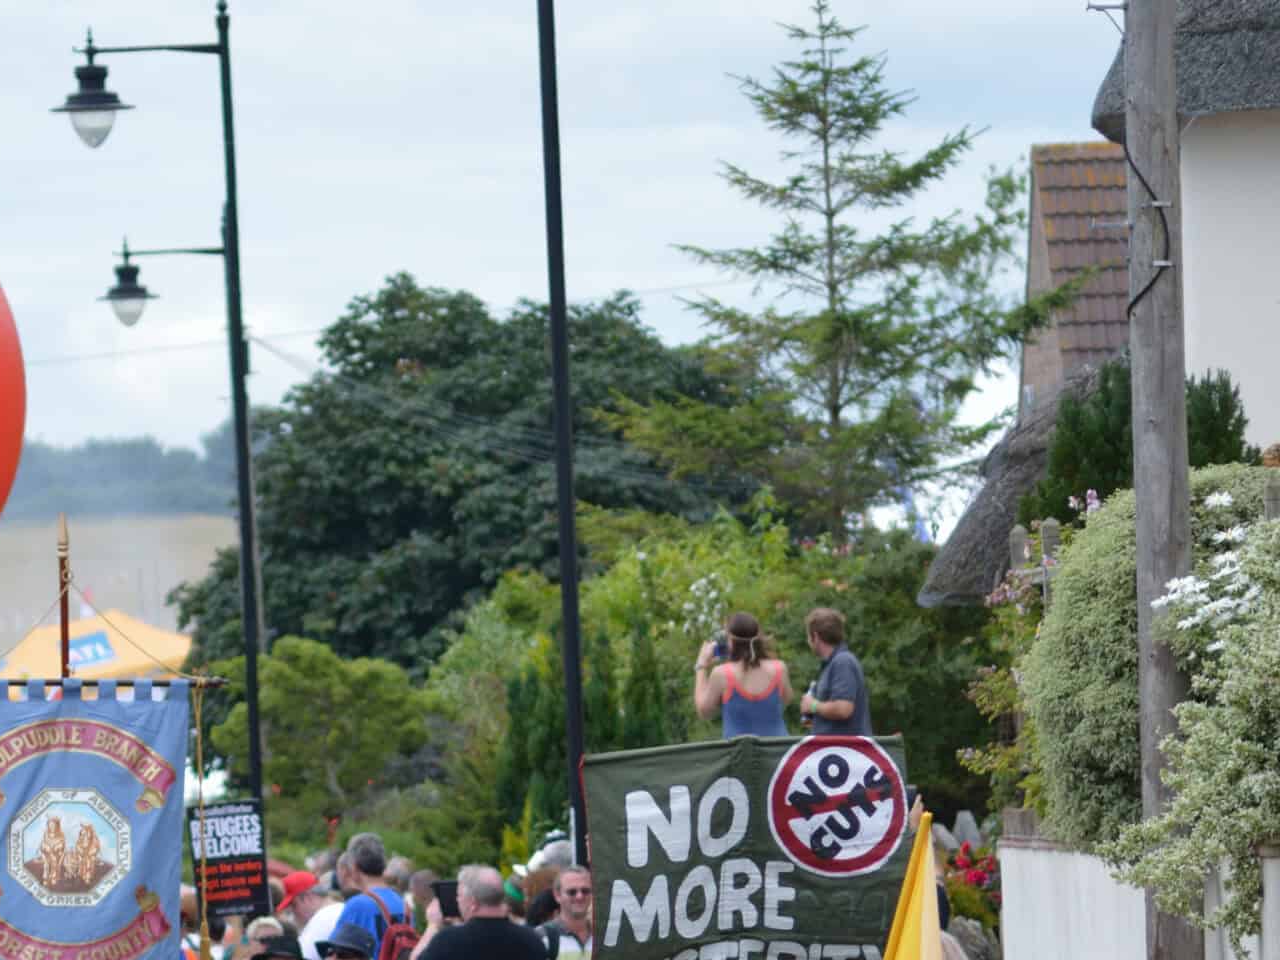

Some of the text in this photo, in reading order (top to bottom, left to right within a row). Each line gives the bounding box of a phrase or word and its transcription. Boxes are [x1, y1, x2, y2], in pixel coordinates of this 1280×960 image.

[95, 729, 163, 782] BRANCH
[788, 753, 849, 821] NO
[190, 813, 262, 839] REFUGEES
[625, 777, 749, 868] NO
[809, 765, 894, 860] CUTS
[192, 834, 263, 860] WELCOME
[604, 857, 796, 948] MORE
